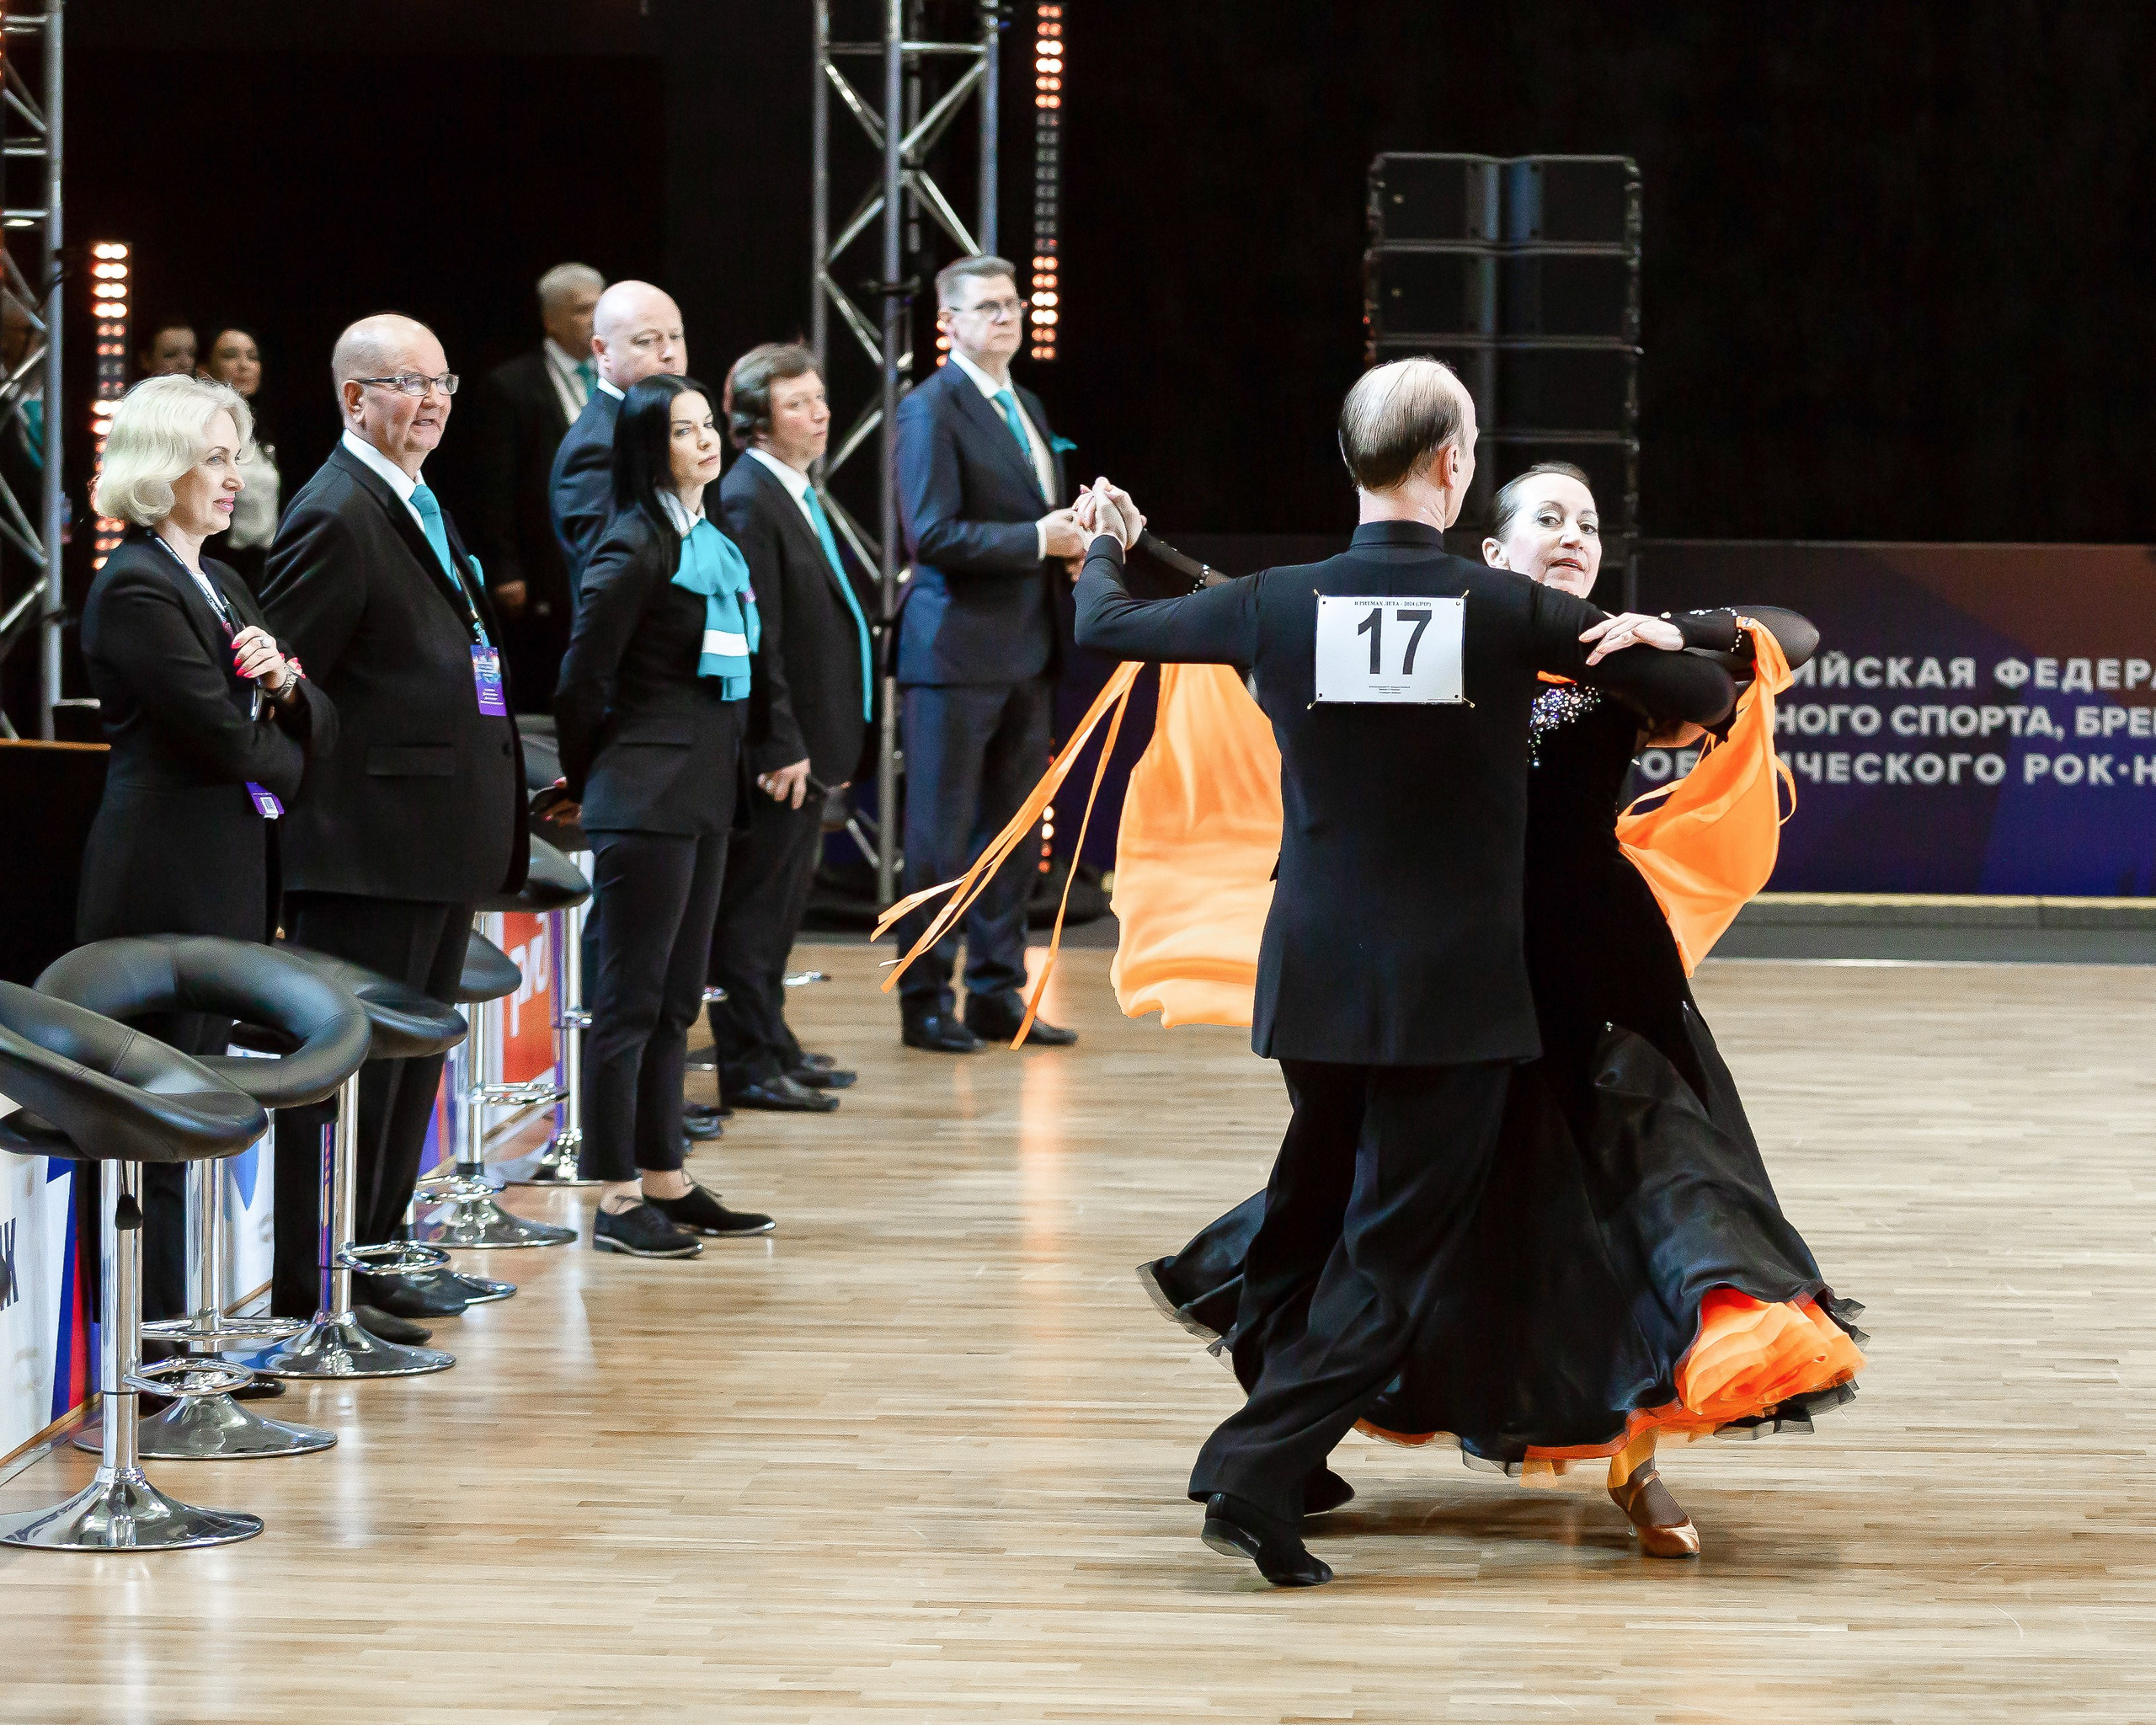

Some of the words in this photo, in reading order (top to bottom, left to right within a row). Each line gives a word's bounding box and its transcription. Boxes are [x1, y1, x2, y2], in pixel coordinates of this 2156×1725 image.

[1358, 608, 1433, 675] 17
[1993, 656, 2156, 695] ФЕДЕР
[1890, 704, 2066, 742] СПОРТА,
[2075, 705, 2156, 739] БРЕ
